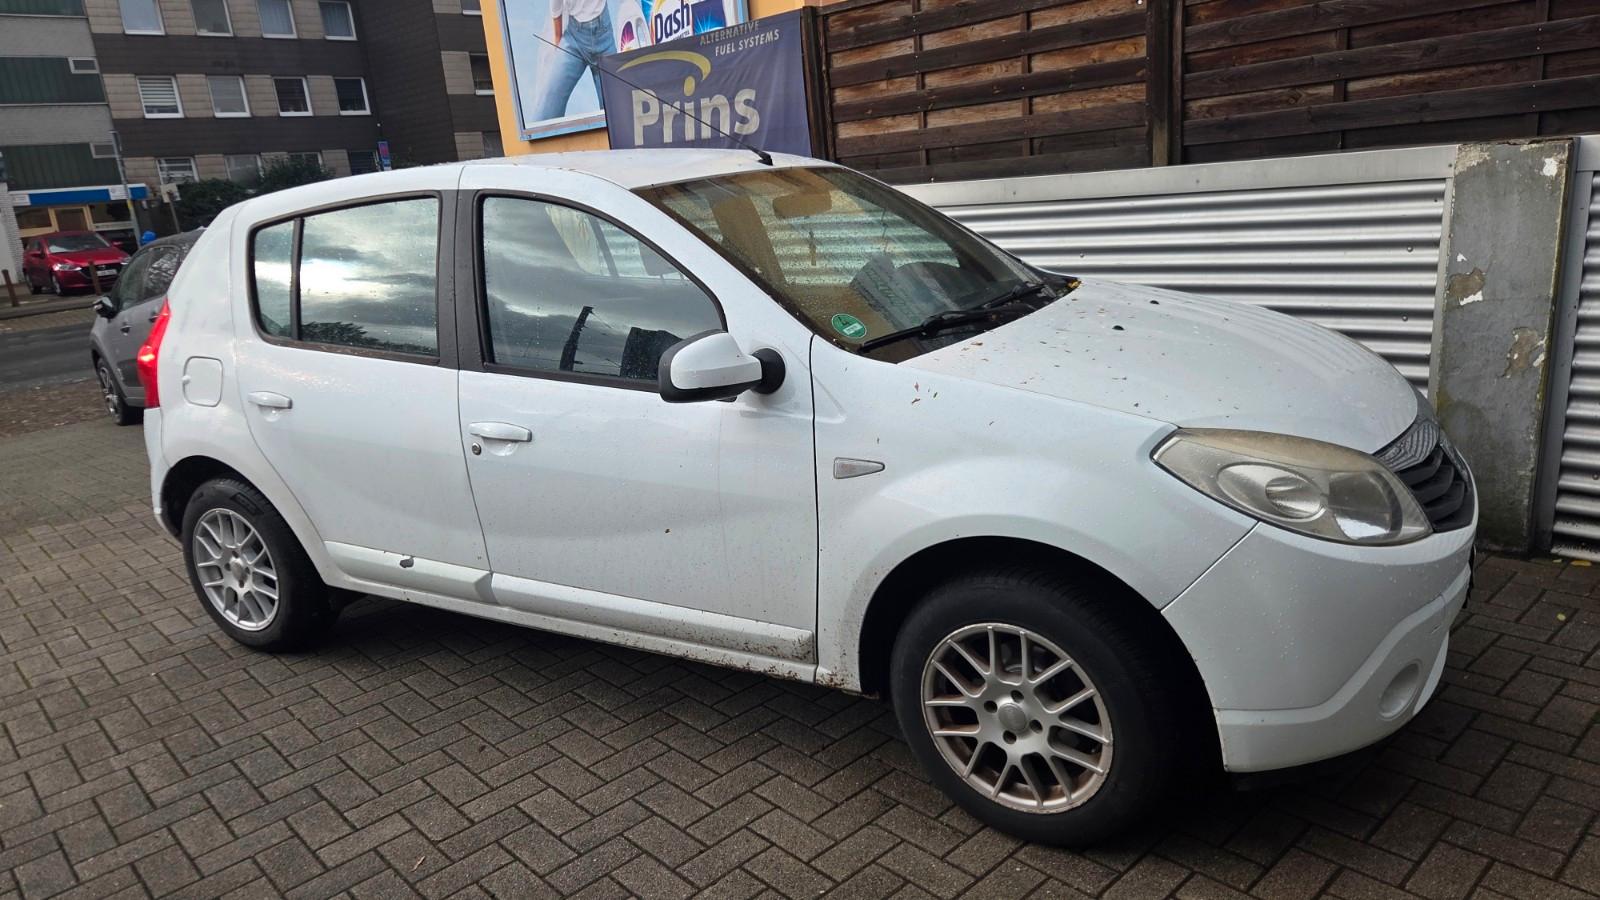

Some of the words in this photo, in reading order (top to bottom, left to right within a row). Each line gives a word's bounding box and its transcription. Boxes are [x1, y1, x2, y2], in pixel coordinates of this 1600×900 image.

[654, 0, 690, 44] Dash
[700, 21, 759, 46] ALTERNATIVE
[715, 43, 736, 57] FUEL
[738, 29, 780, 51] SYSTEMS
[632, 76, 761, 146] Prins
